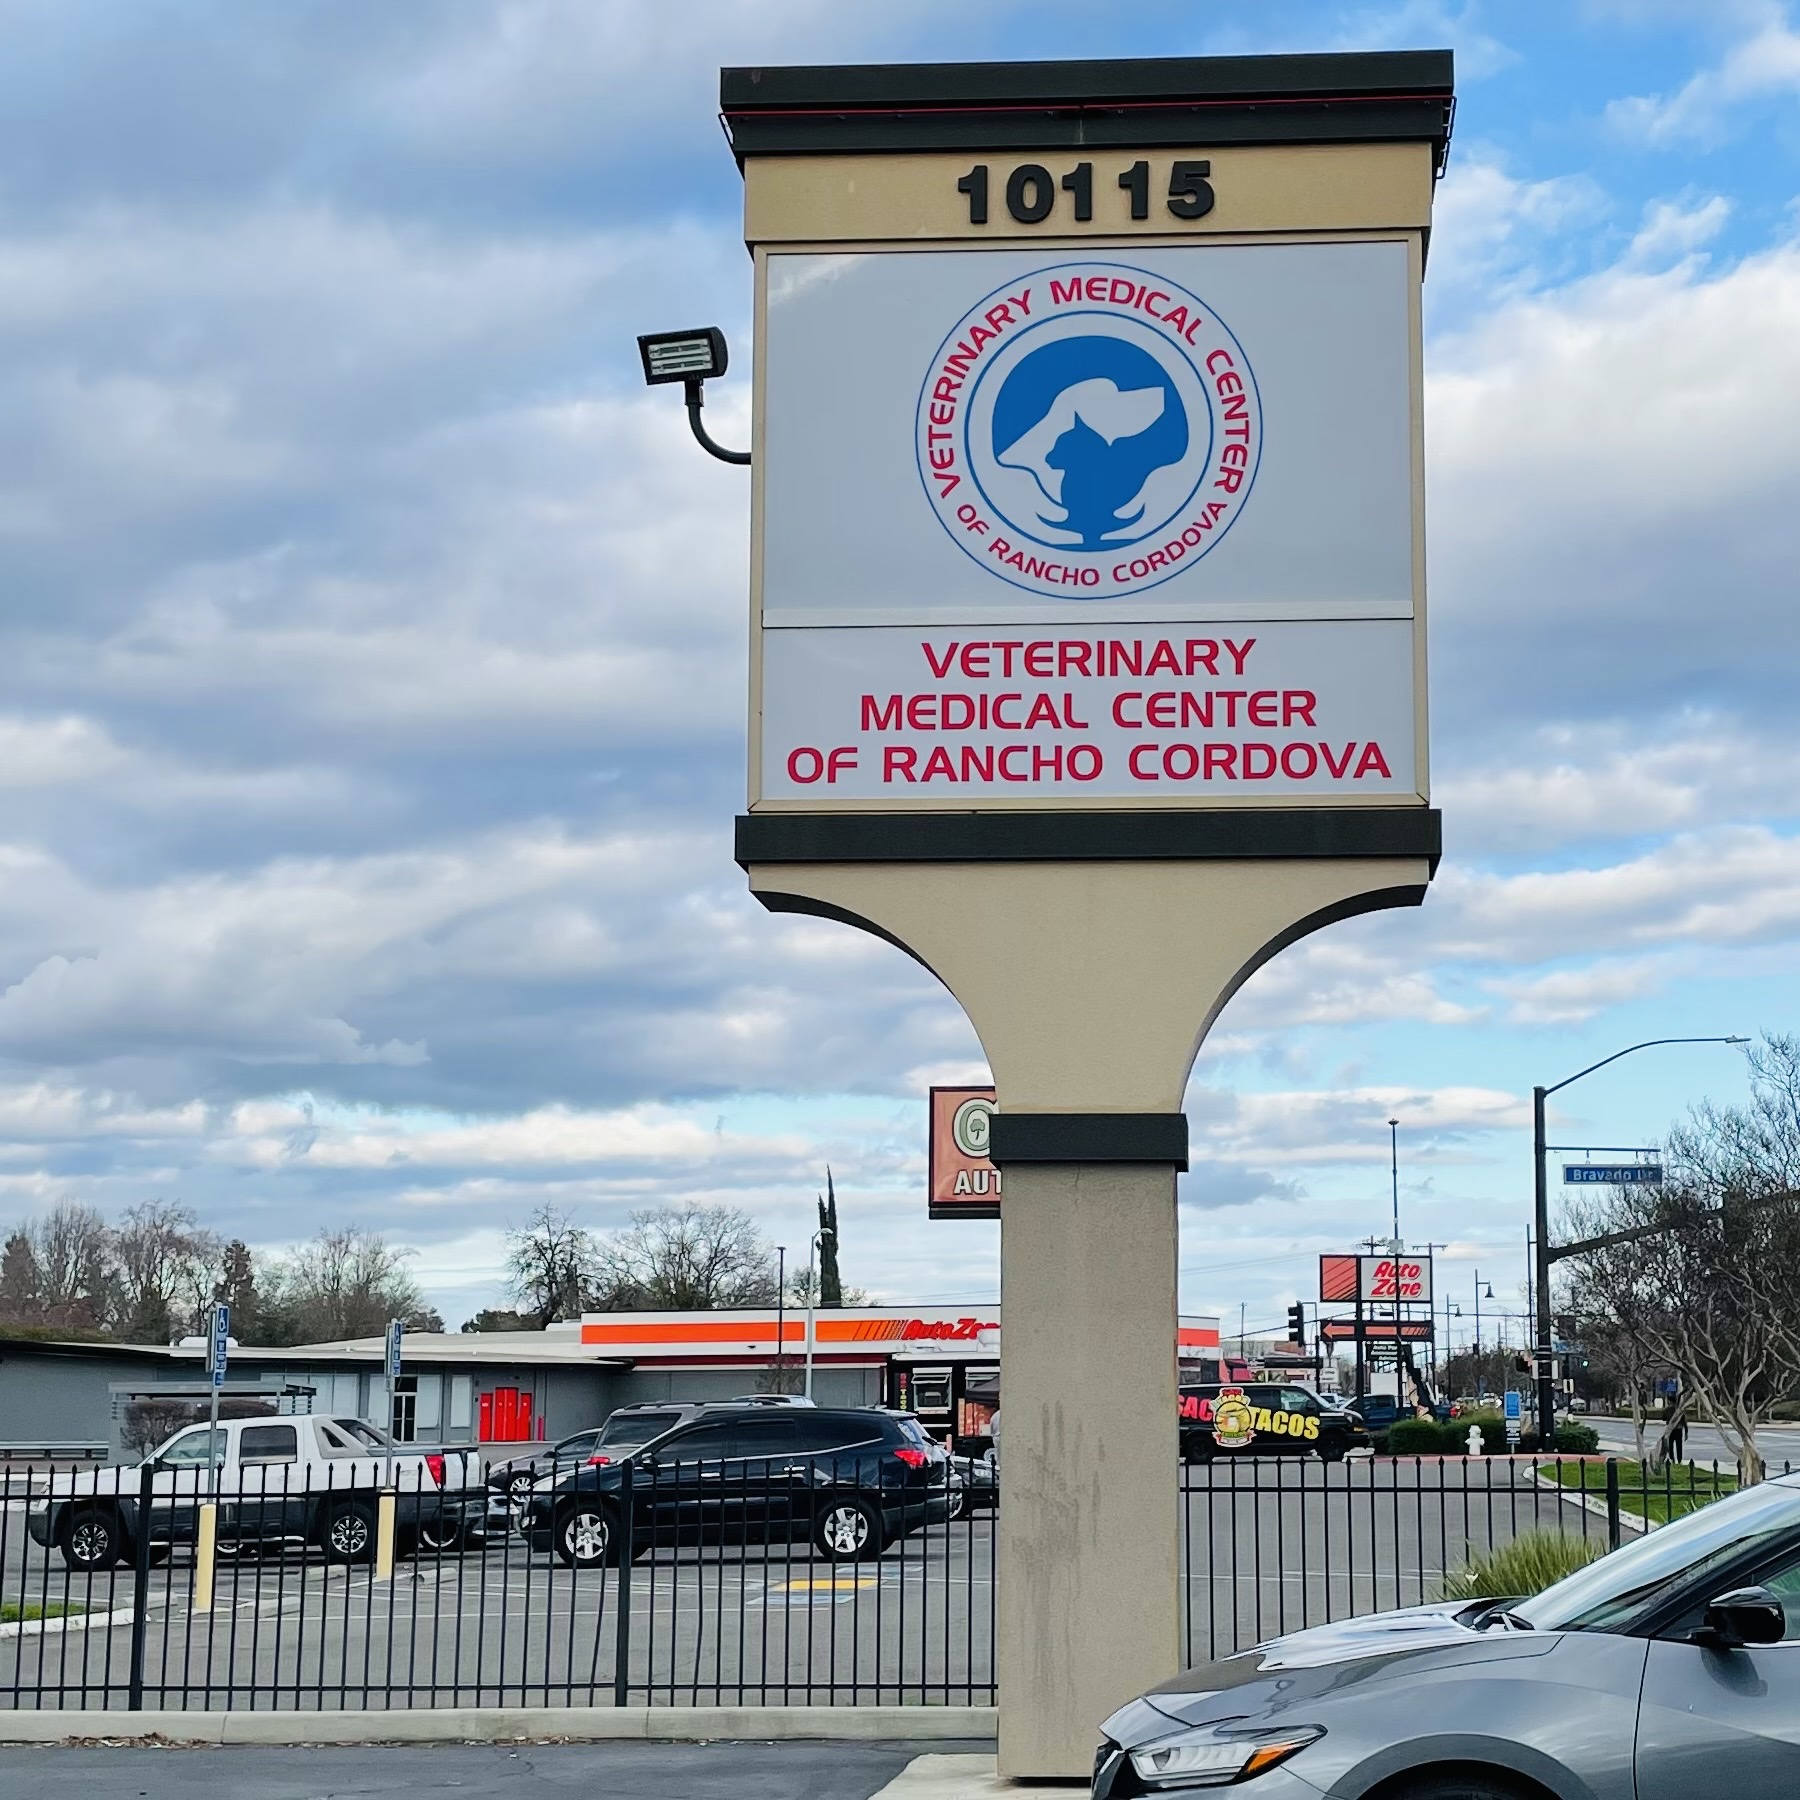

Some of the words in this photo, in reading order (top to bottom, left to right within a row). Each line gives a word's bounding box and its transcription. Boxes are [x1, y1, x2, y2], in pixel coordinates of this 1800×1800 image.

[957, 159, 1216, 226] 10115
[927, 288, 1032, 499] VETERINARY
[1049, 276, 1202, 346] MEDICAL
[1205, 349, 1250, 494] CENTER
[956, 503, 991, 536] OF
[988, 537, 1101, 586] RANCHO
[1112, 499, 1228, 583] CORDOVA
[921, 638, 1257, 679] VETERINARY
[860, 692, 1089, 731] MEDICAL
[1111, 690, 1318, 729] CENTER
[786, 746, 859, 785] OF
[882, 743, 1104, 783] RANCHO
[1128, 741, 1393, 781] CORDOVA
[1572, 1168, 1632, 1181] Bravado
[1369, 1278, 1422, 1297] Zone
[1371, 1260, 1422, 1280] Auto
[1249, 1406, 1321, 1440] TACOS
